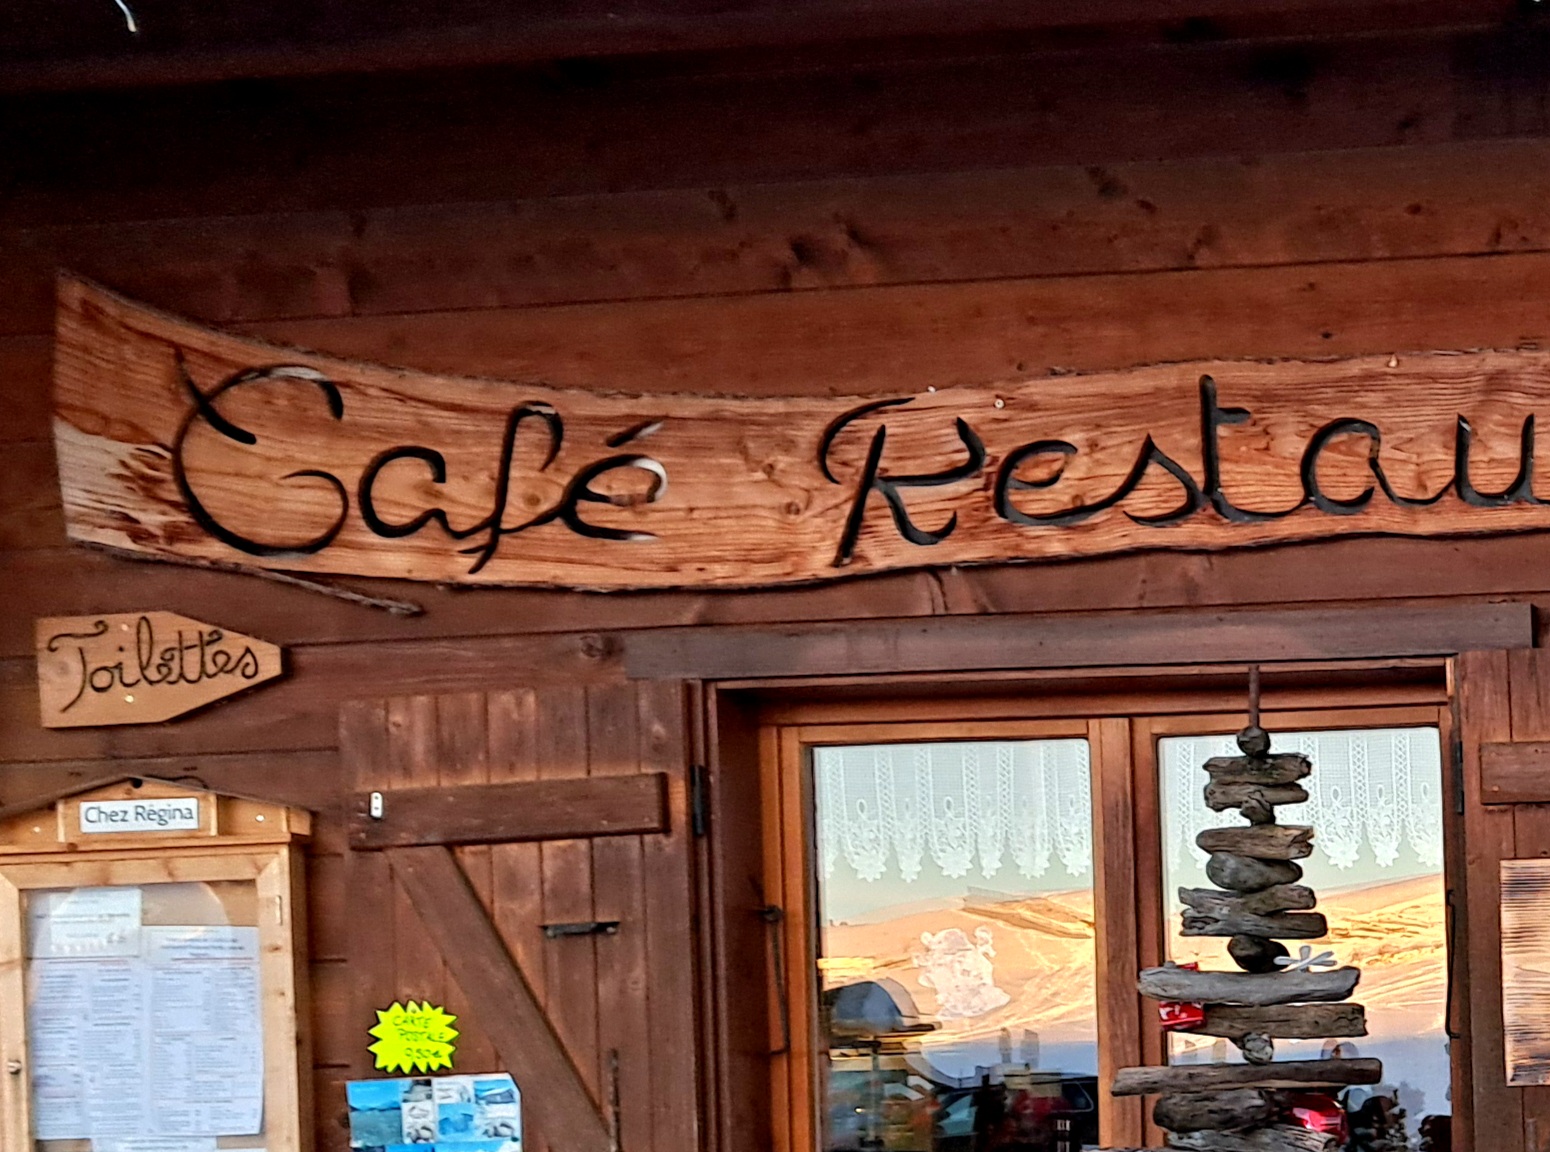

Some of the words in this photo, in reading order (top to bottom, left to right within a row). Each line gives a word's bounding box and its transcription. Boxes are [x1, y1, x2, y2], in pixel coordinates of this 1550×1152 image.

[171, 346, 668, 574] Café
[47, 616, 259, 713] Toilettes
[84, 806, 128, 823] Chez
